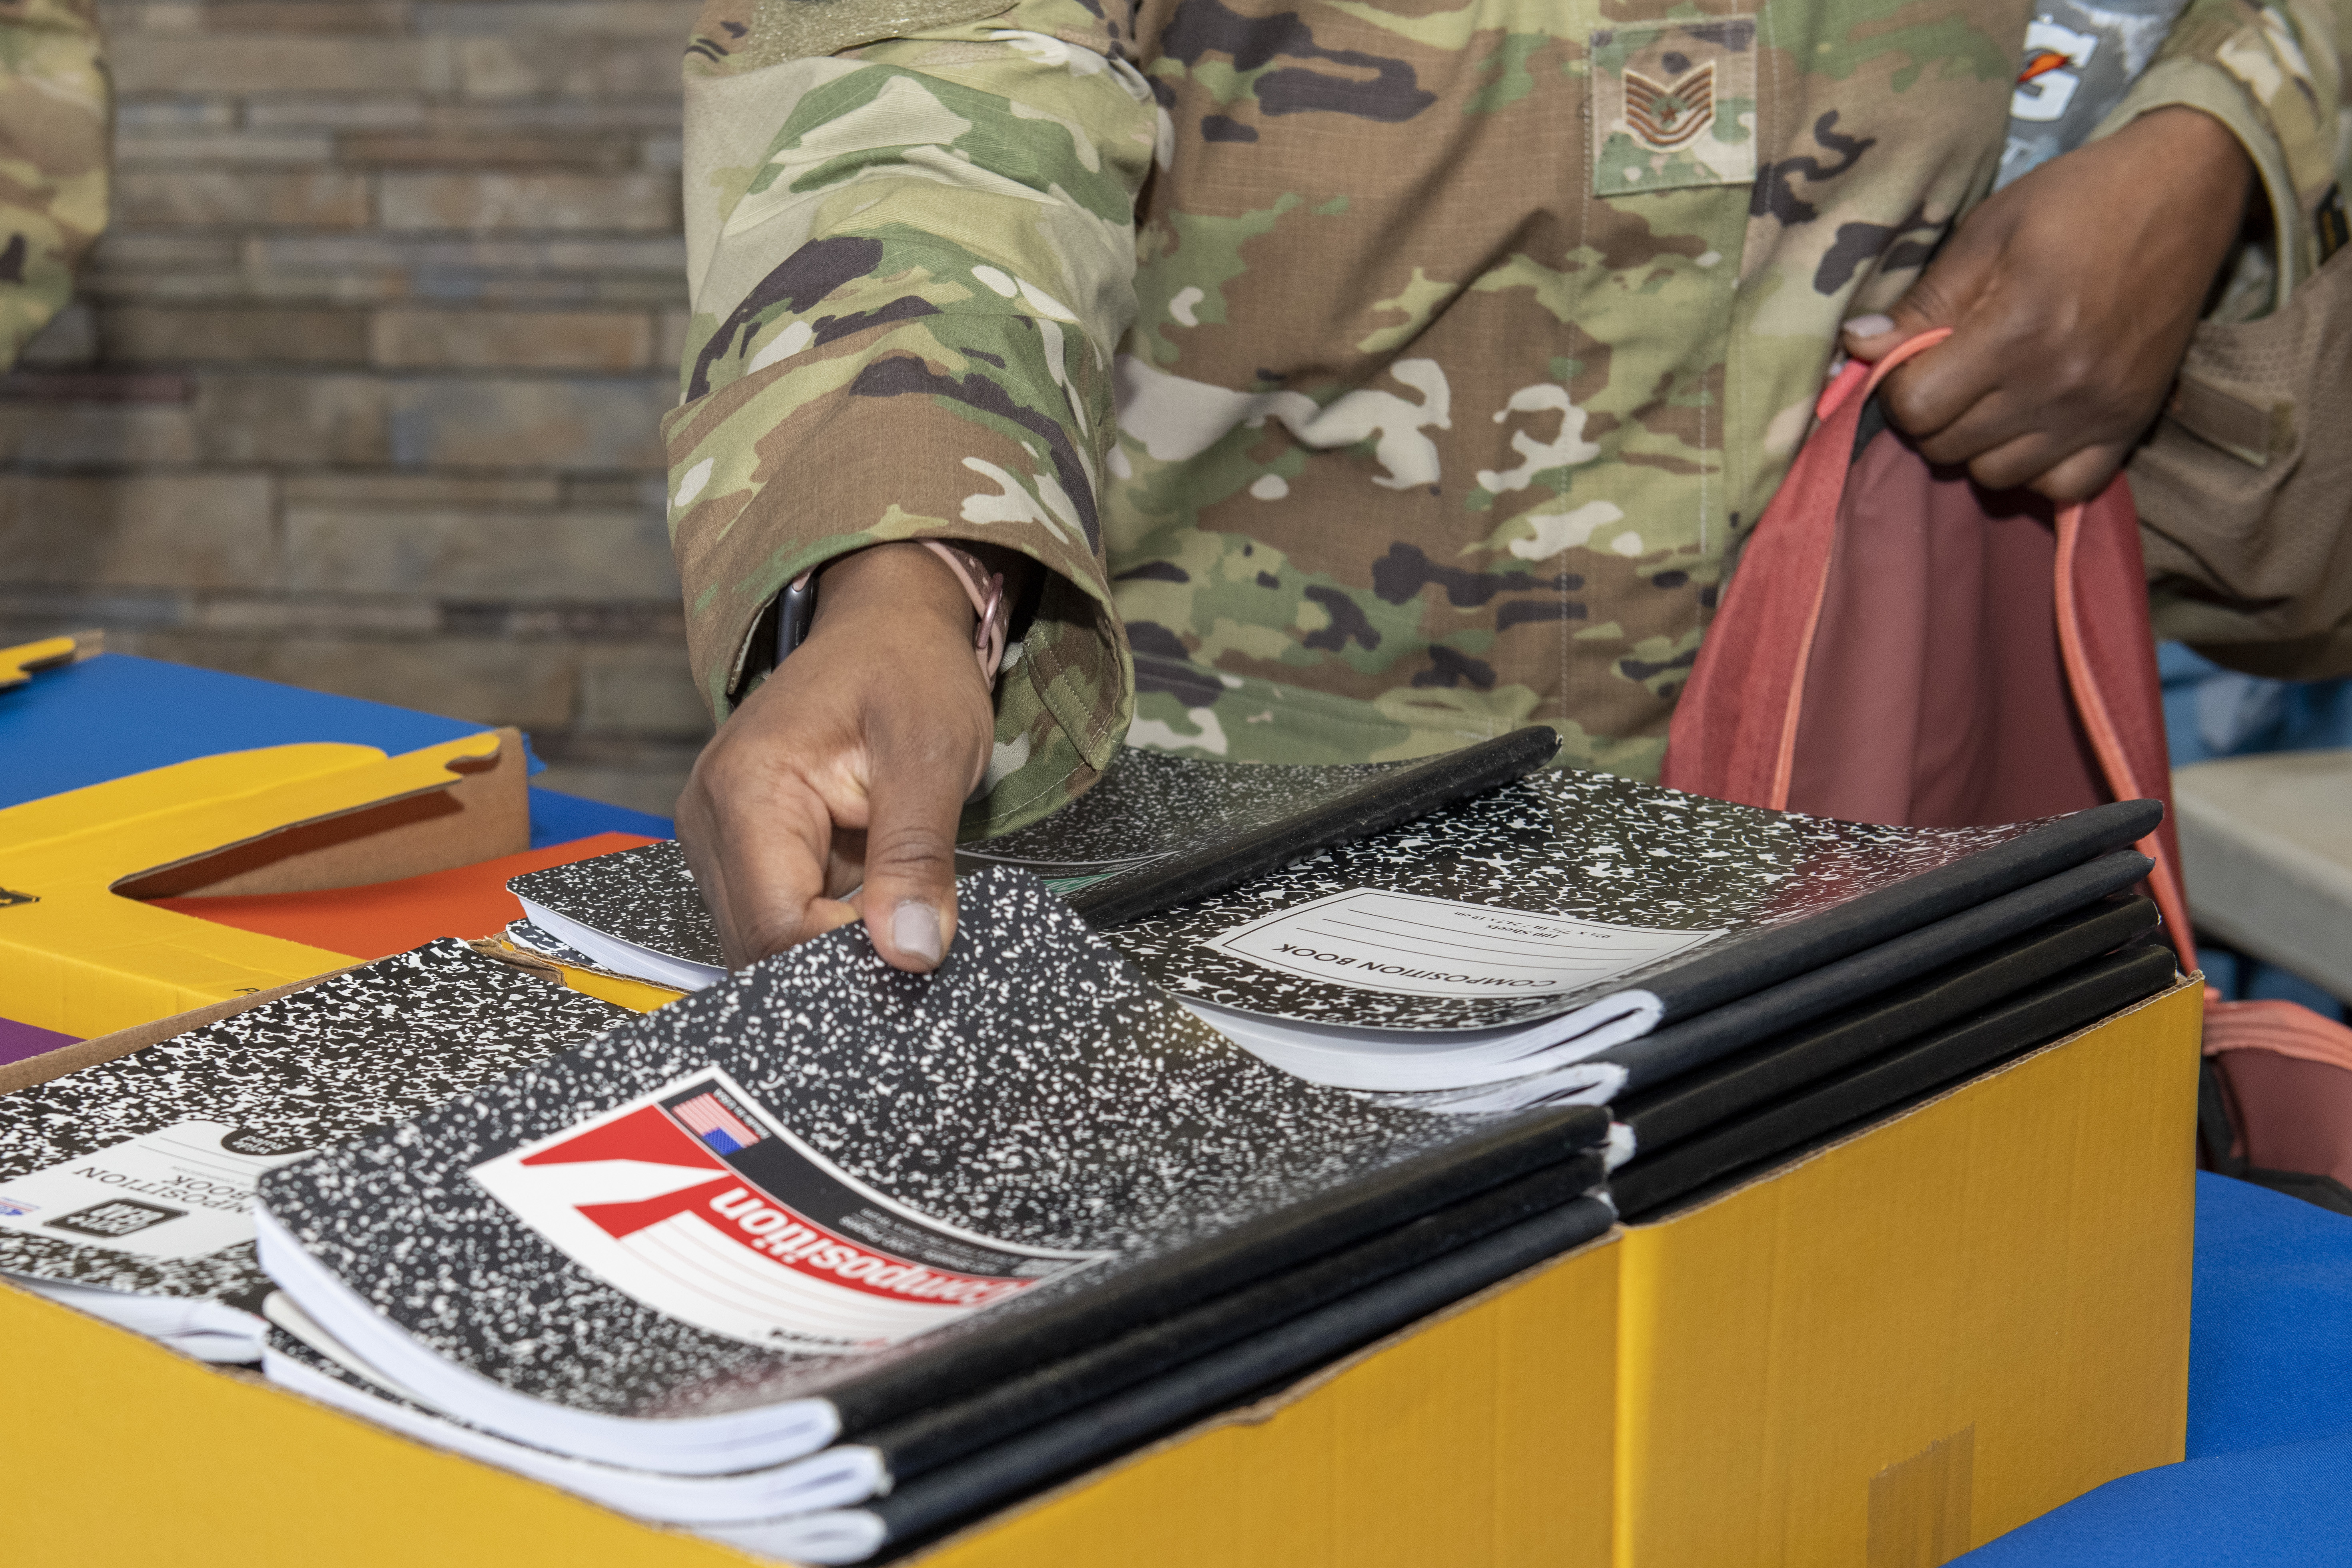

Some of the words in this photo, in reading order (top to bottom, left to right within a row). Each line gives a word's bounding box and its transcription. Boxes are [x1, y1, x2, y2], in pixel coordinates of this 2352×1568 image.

[1485, 924, 1532, 935] Sheets
[1533, 930, 1560, 939] 100
[1271, 943, 1359, 966] BOOK
[1357, 962, 1556, 987] COMPOSITION
[73, 1167, 255, 1215] MPOSITION
[161, 1175, 257, 1200] BOOK
[709, 1185, 1019, 1306] Composition
